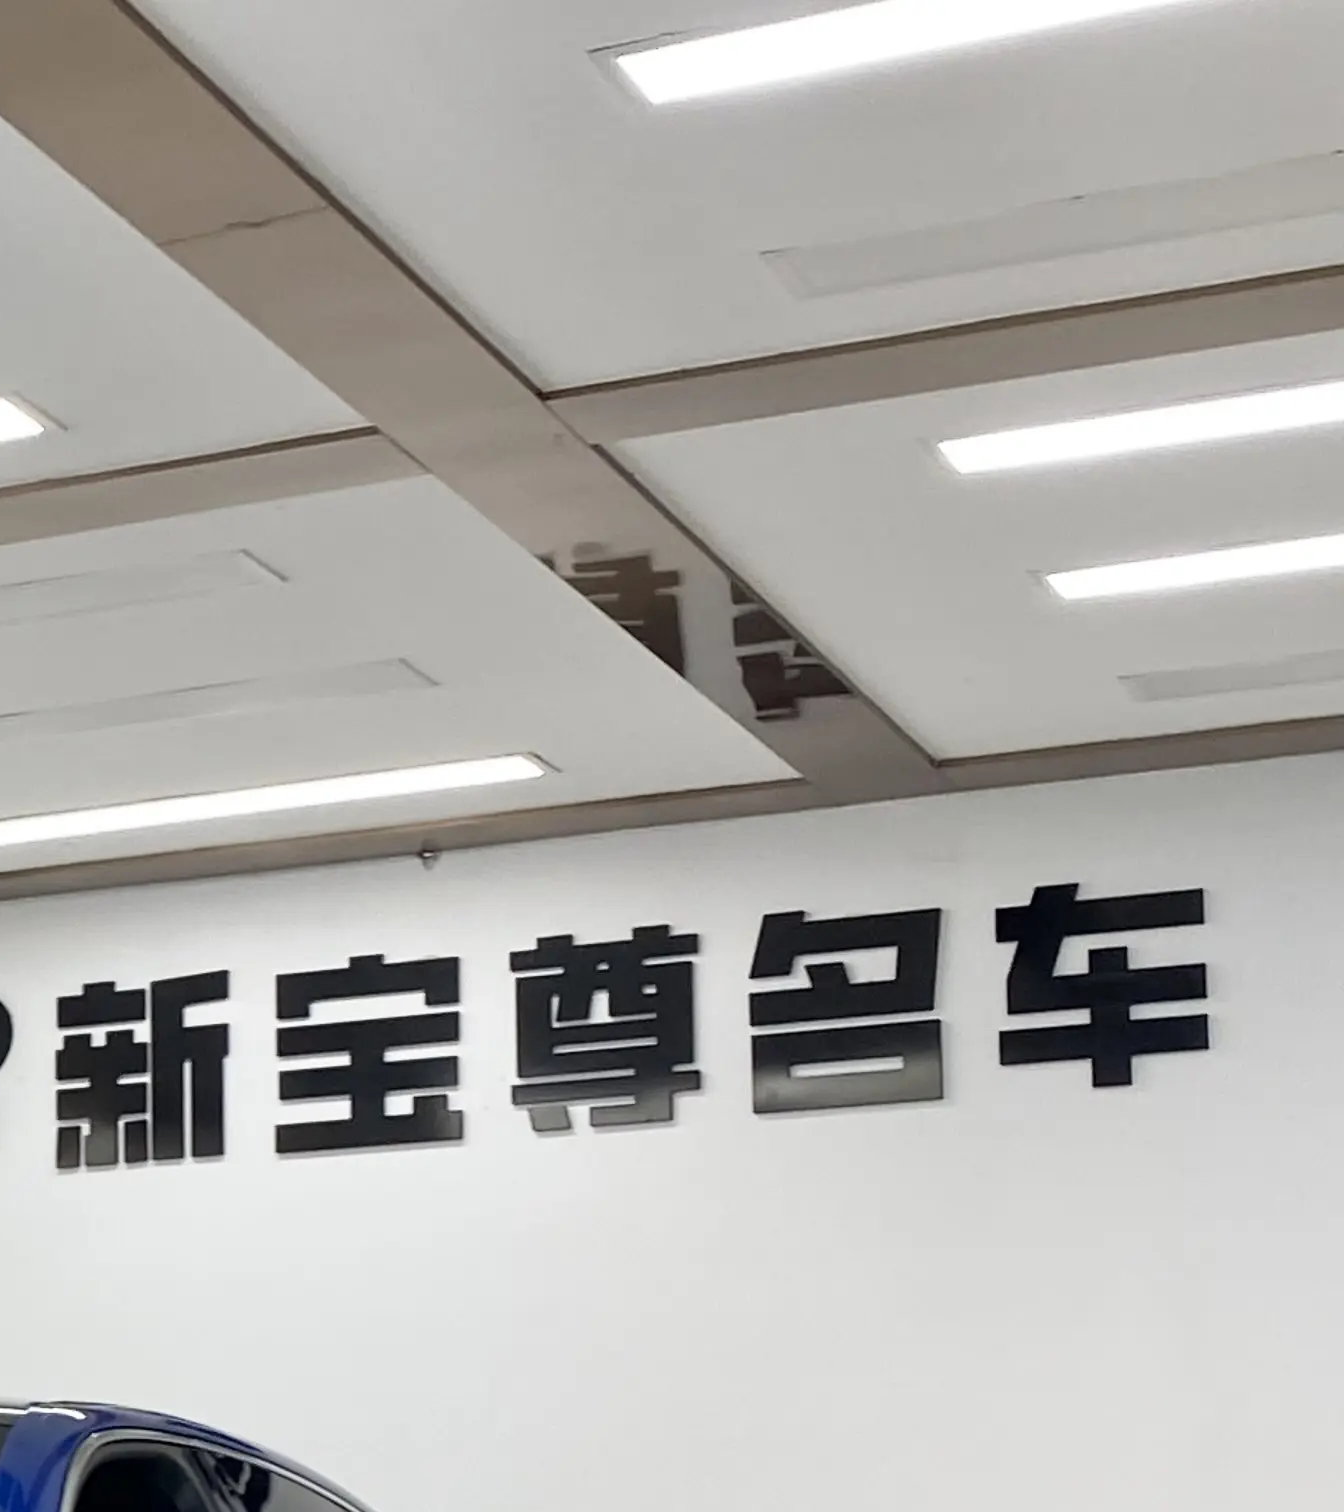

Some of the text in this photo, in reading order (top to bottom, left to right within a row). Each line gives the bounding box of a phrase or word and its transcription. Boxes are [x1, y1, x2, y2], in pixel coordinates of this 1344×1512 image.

[55, 884, 1210, 1169] 新宝尊名车
